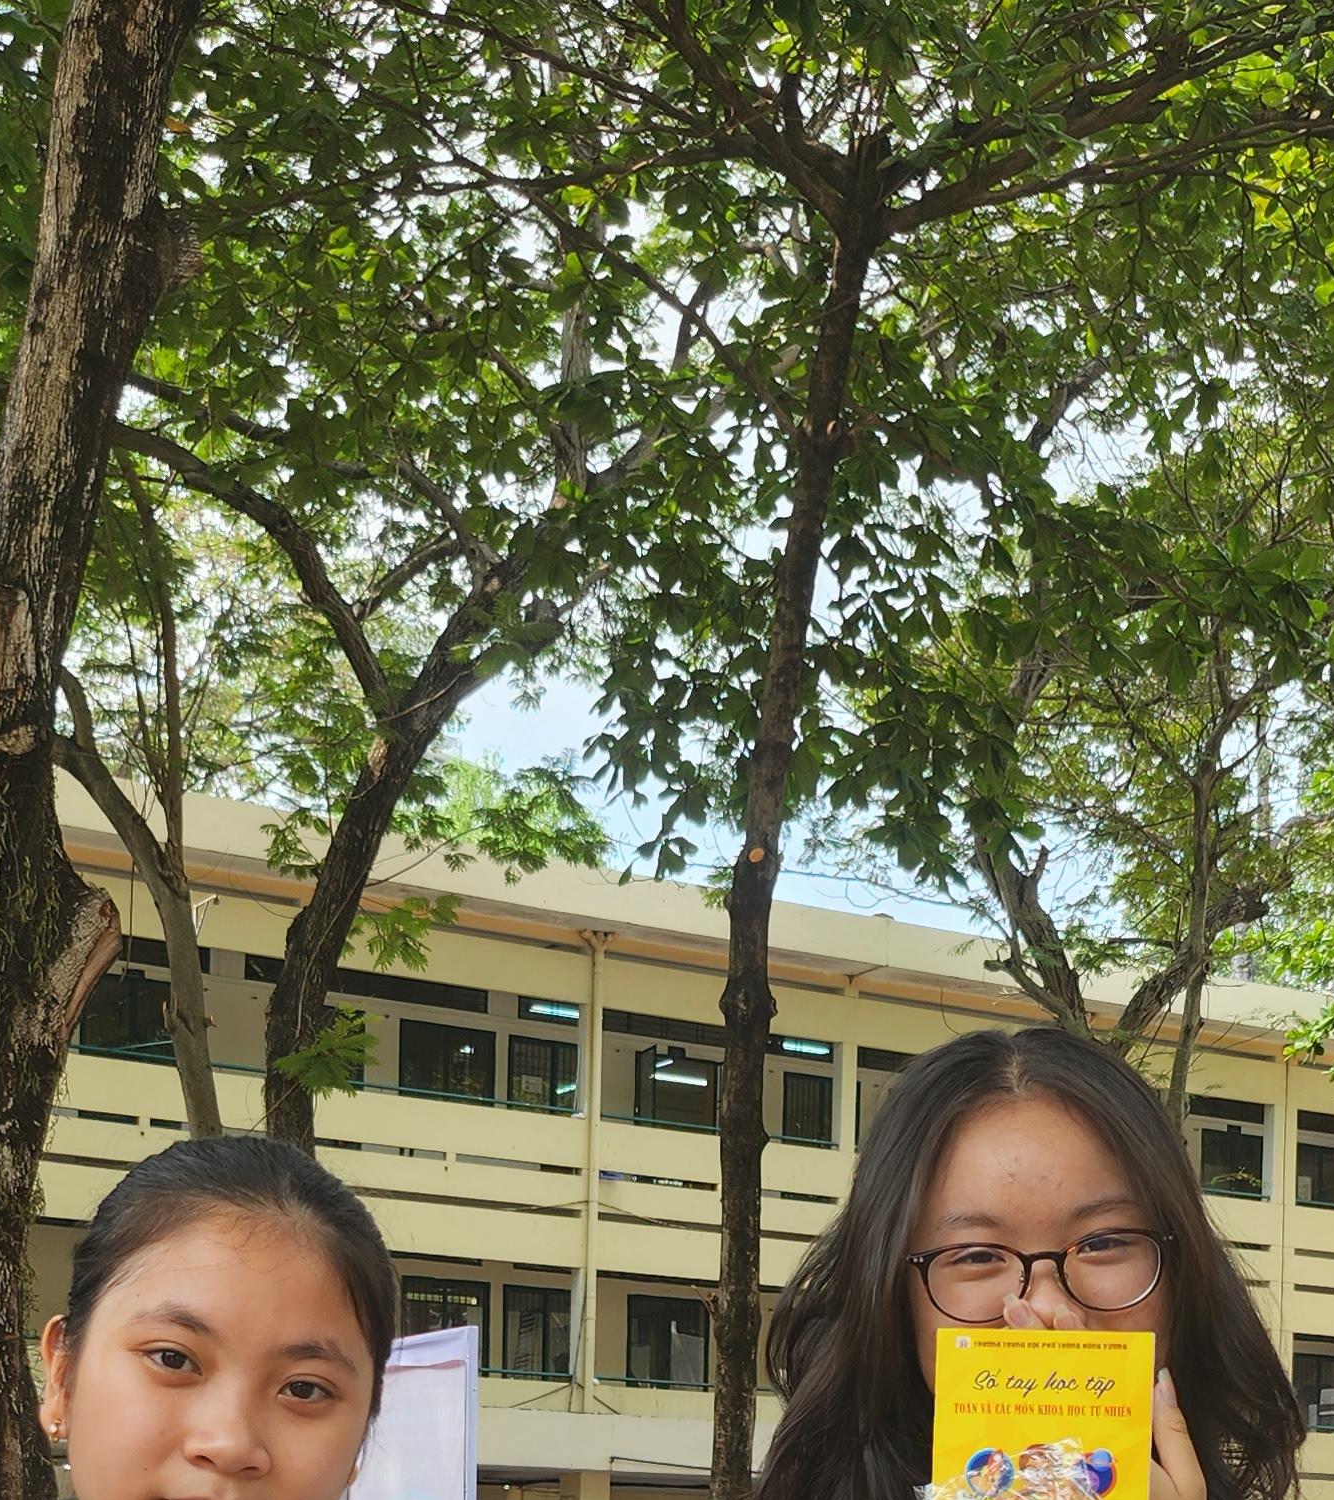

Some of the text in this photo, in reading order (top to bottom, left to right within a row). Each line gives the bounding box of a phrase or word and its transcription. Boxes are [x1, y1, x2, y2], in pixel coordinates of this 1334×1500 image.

[1005, 1374, 1038, 1398] tay
[1043, 1370, 1079, 1394] học
[1085, 1376, 1116, 1400] tập
[1037, 1406, 1065, 1417] KHOA
[1067, 1406, 1087, 1418] HỌC
